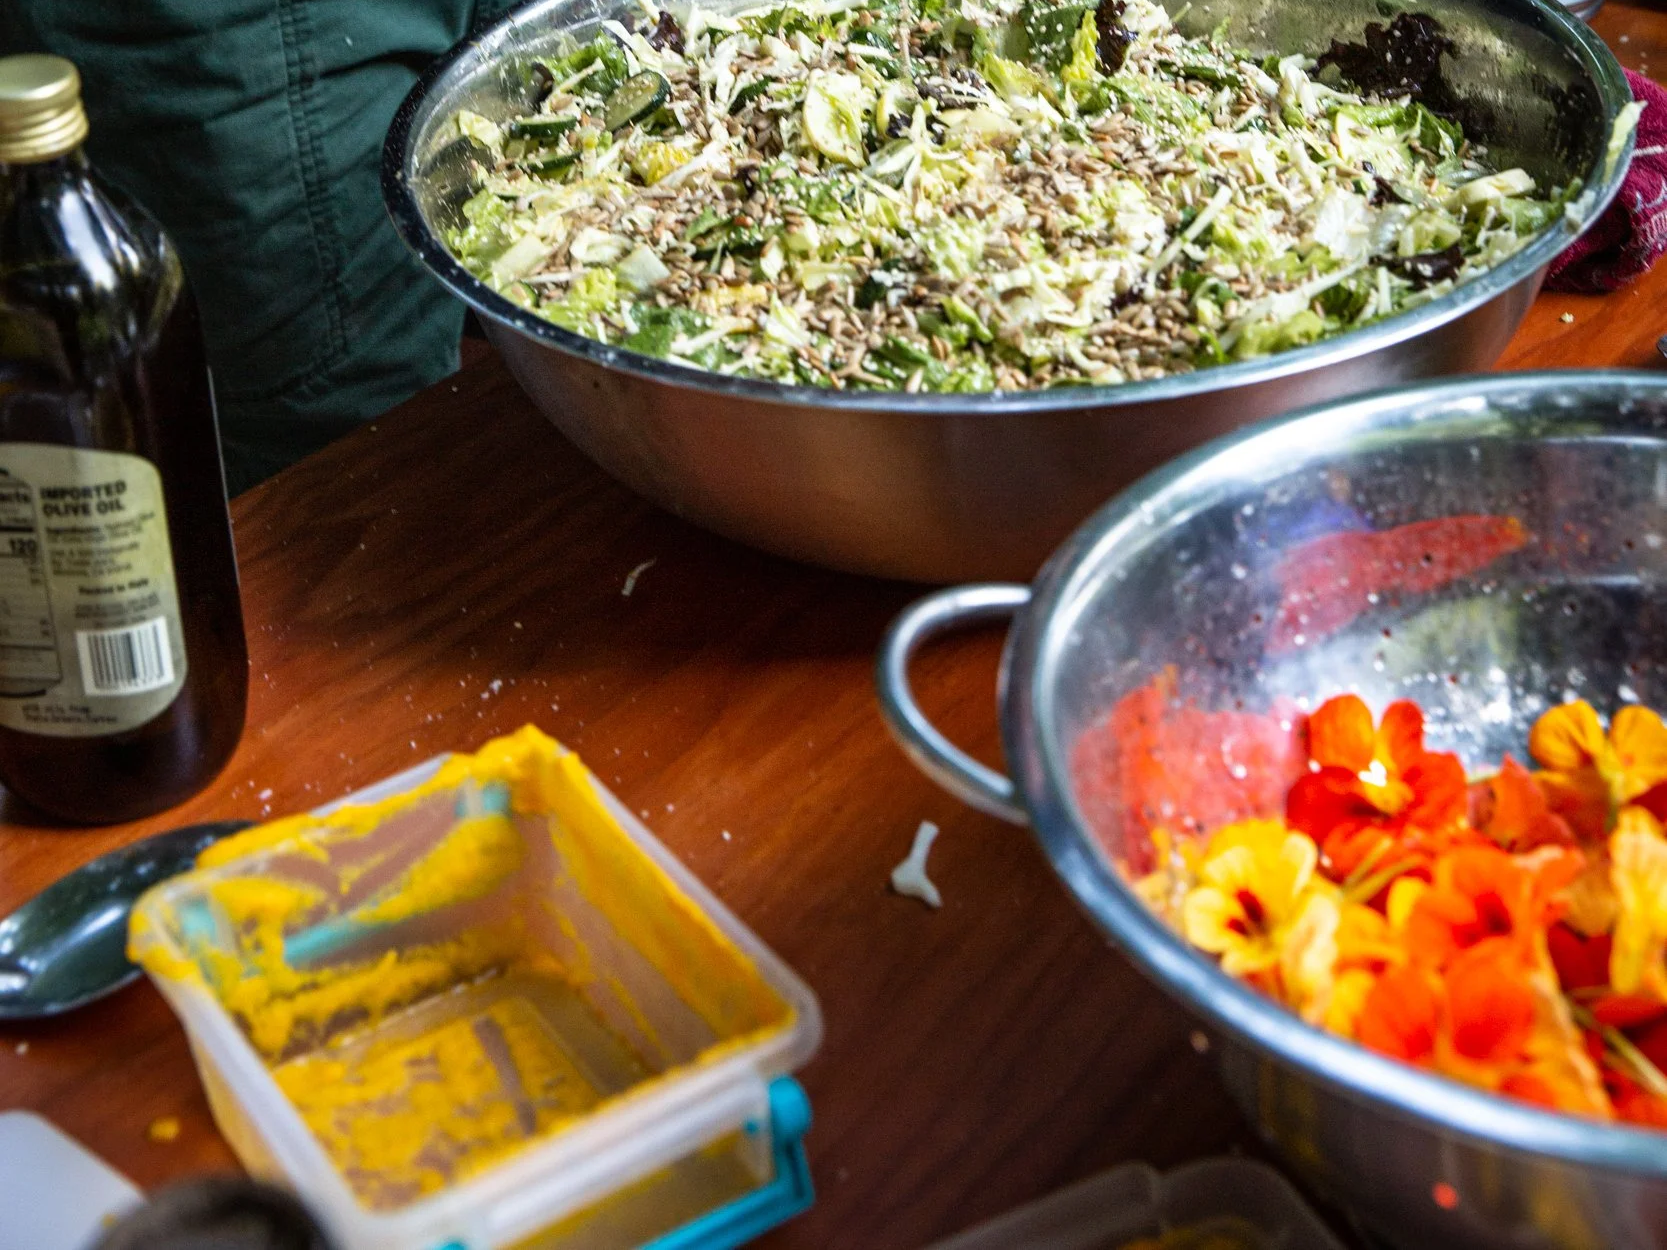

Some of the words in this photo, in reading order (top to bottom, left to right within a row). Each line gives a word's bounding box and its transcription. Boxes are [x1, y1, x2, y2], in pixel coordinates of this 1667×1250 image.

[41, 480, 127, 500] IMPORTED
[43, 502, 91, 518] OLIVE
[97, 498, 125, 515] OIL
